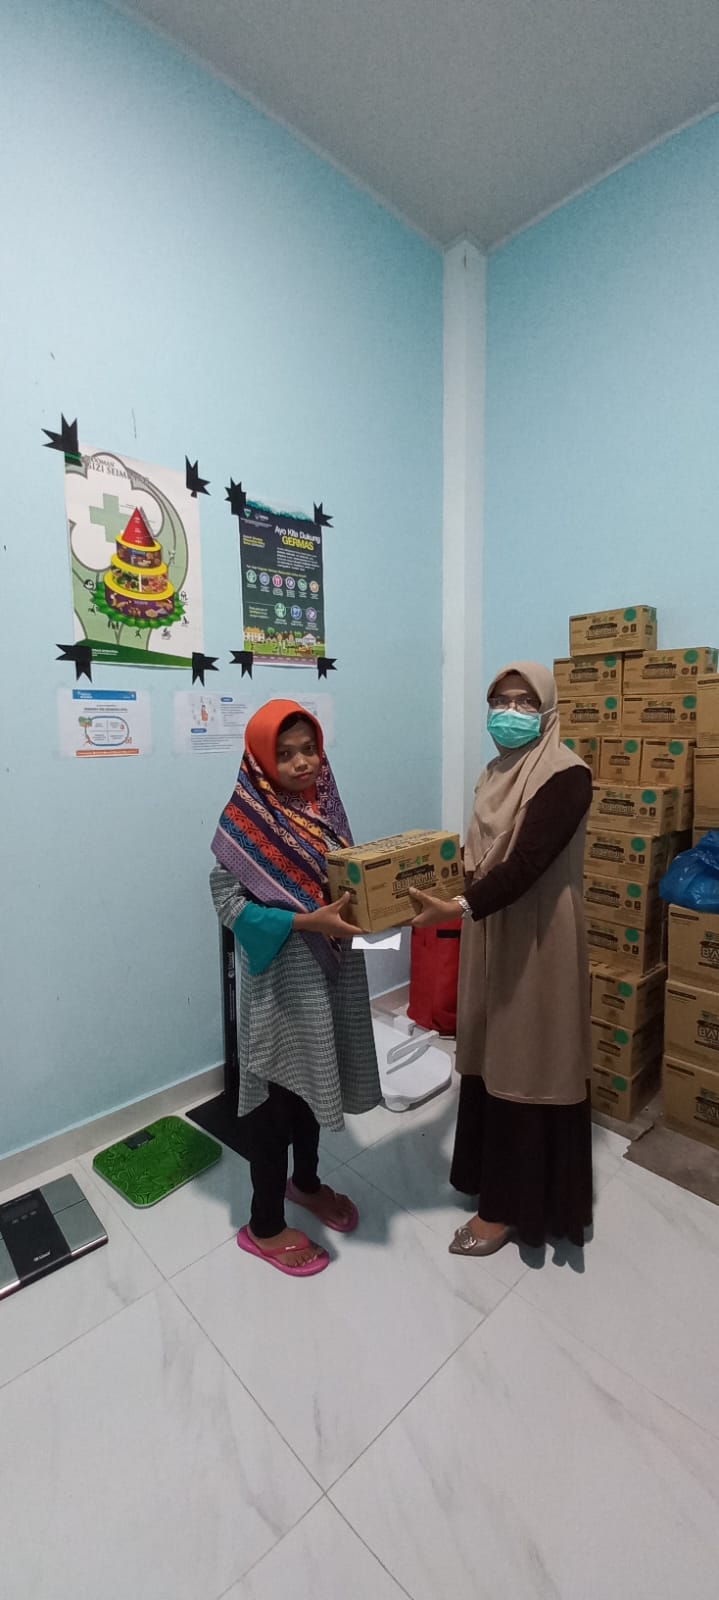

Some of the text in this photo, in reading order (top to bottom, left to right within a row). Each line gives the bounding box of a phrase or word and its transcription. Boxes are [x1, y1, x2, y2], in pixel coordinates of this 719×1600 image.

[275, 525, 320, 544] Ayo Kita Dukung
[282, 535, 314, 551] GERMAS
